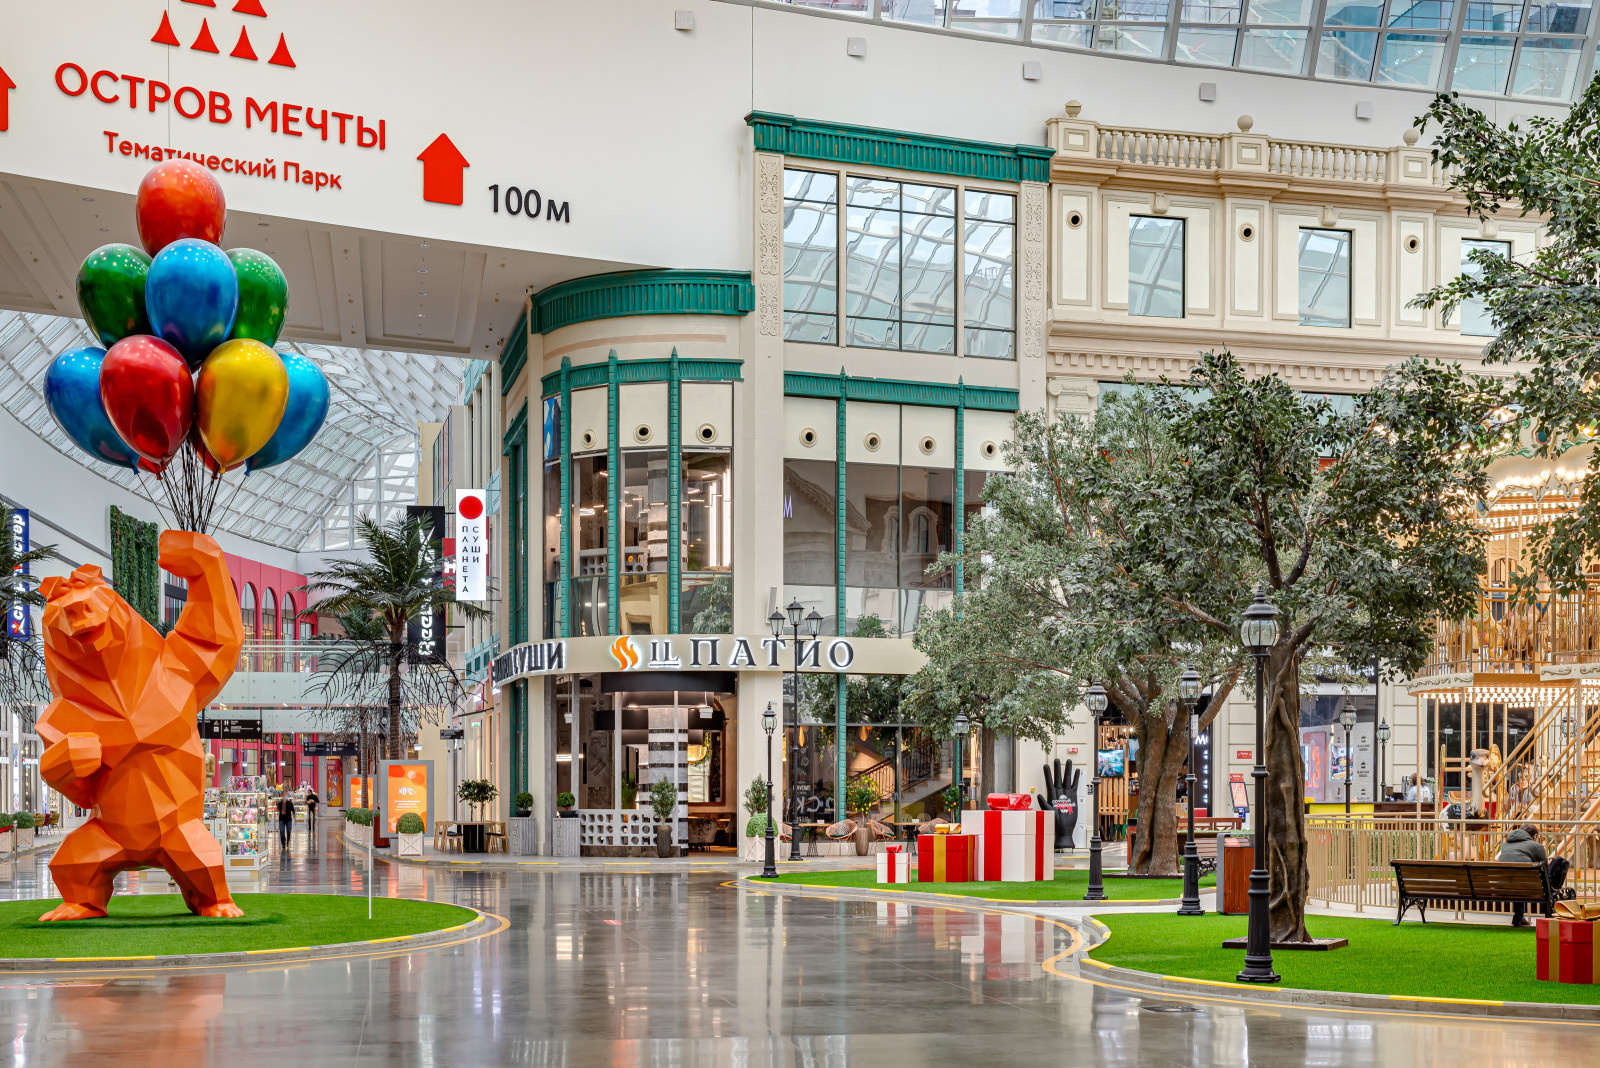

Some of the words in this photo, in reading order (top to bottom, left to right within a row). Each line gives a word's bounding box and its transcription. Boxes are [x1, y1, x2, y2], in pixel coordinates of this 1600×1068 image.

[55, 62, 233, 124] ОСТРОВ
[245, 96, 386, 150] МЕЧТЫ
[103, 130, 276, 180] Тематический
[283, 160, 342, 191] Парк
[471, 525, 481, 564] СУШИ
[418, 577, 436, 656] Reeb
[690, 638, 854, 668] ПАТИО
